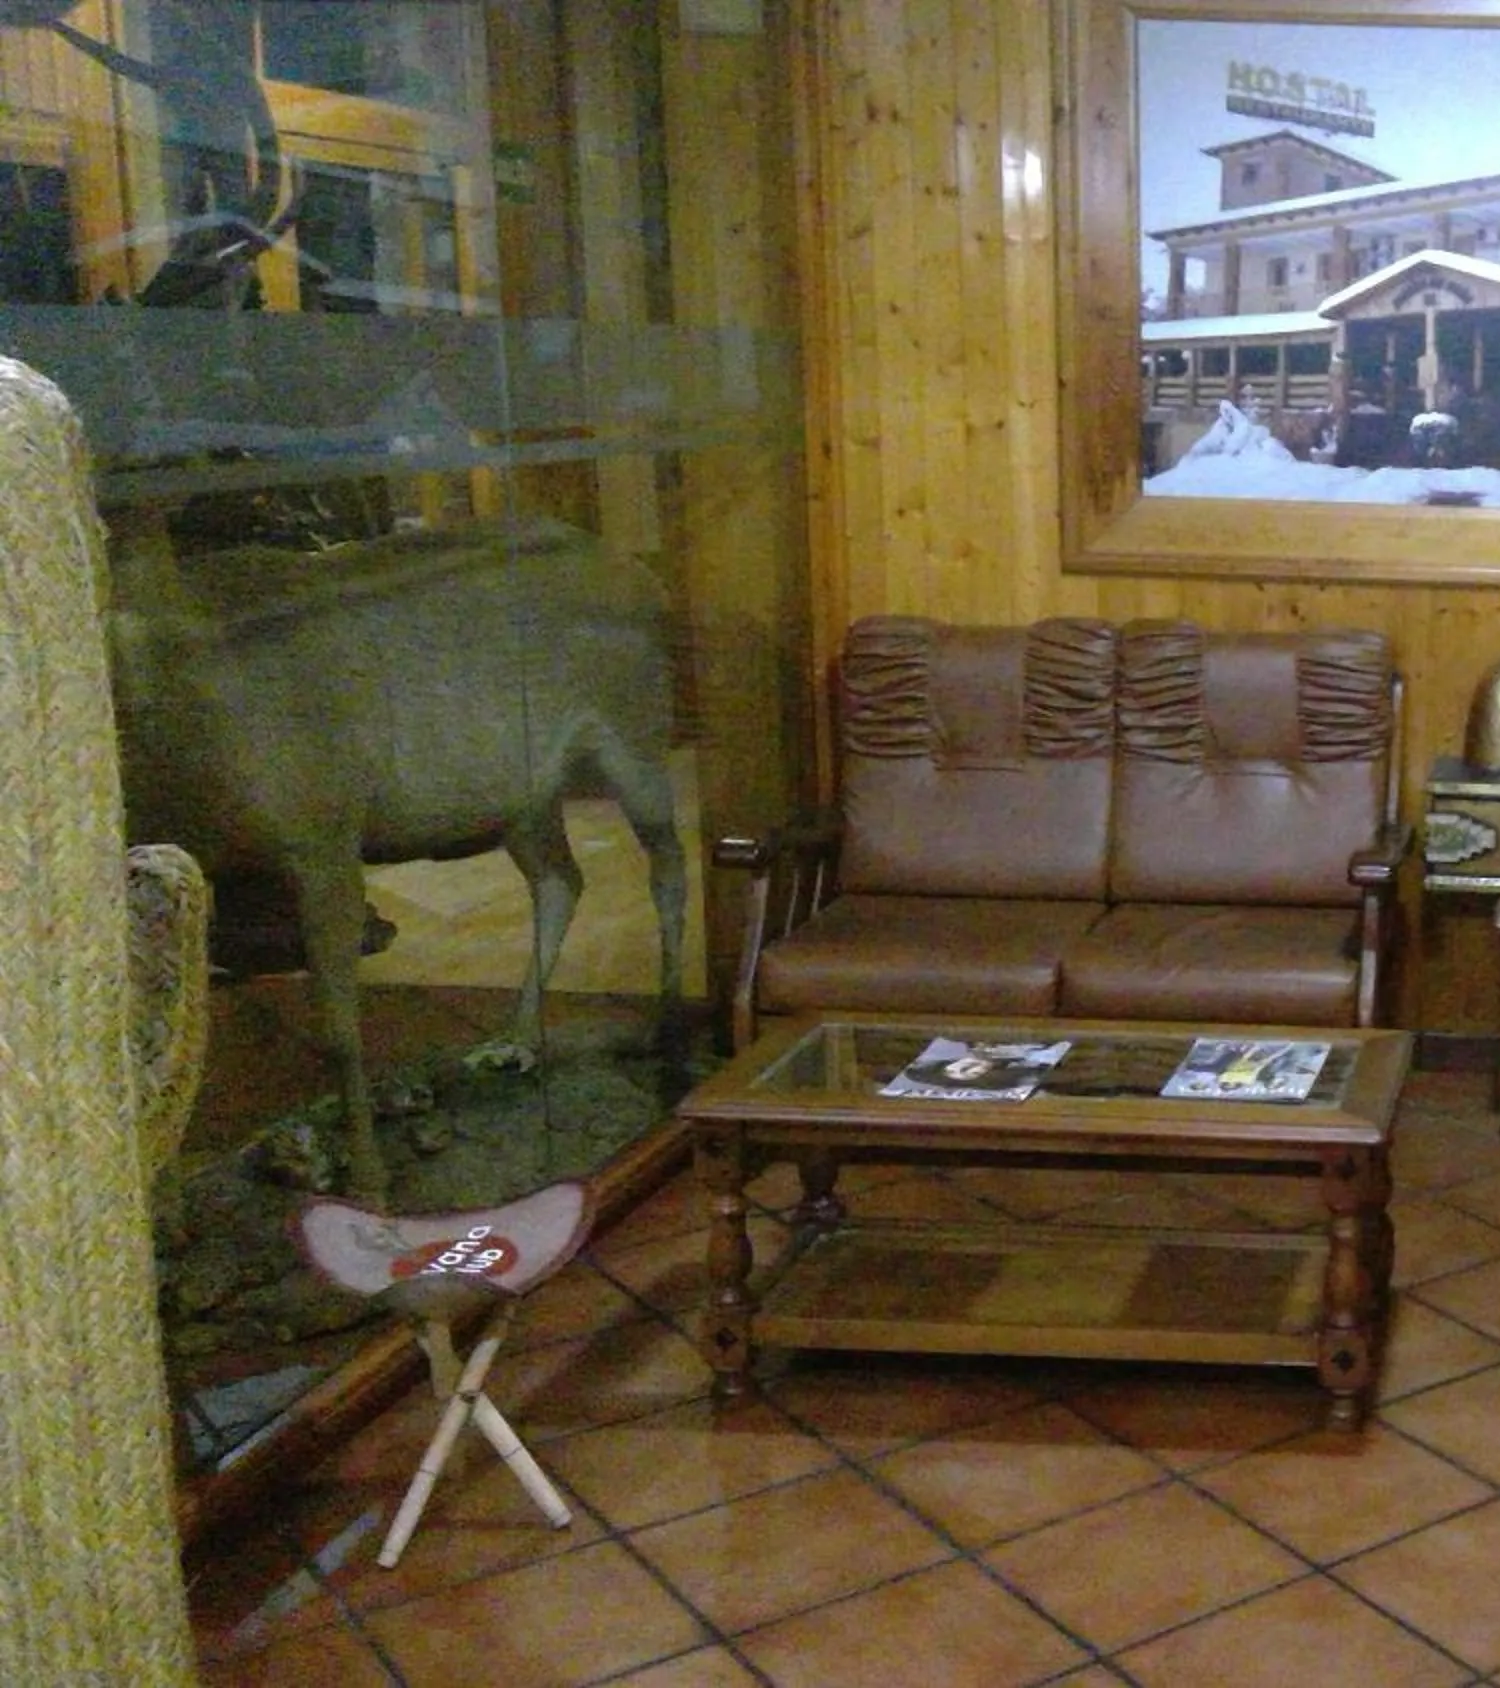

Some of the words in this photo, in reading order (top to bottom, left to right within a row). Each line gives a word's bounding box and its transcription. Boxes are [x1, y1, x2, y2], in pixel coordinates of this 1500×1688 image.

[1228, 60, 1376, 117] HOSTAL
[420, 1225, 494, 1275] vana
[455, 1248, 504, 1274] lub
